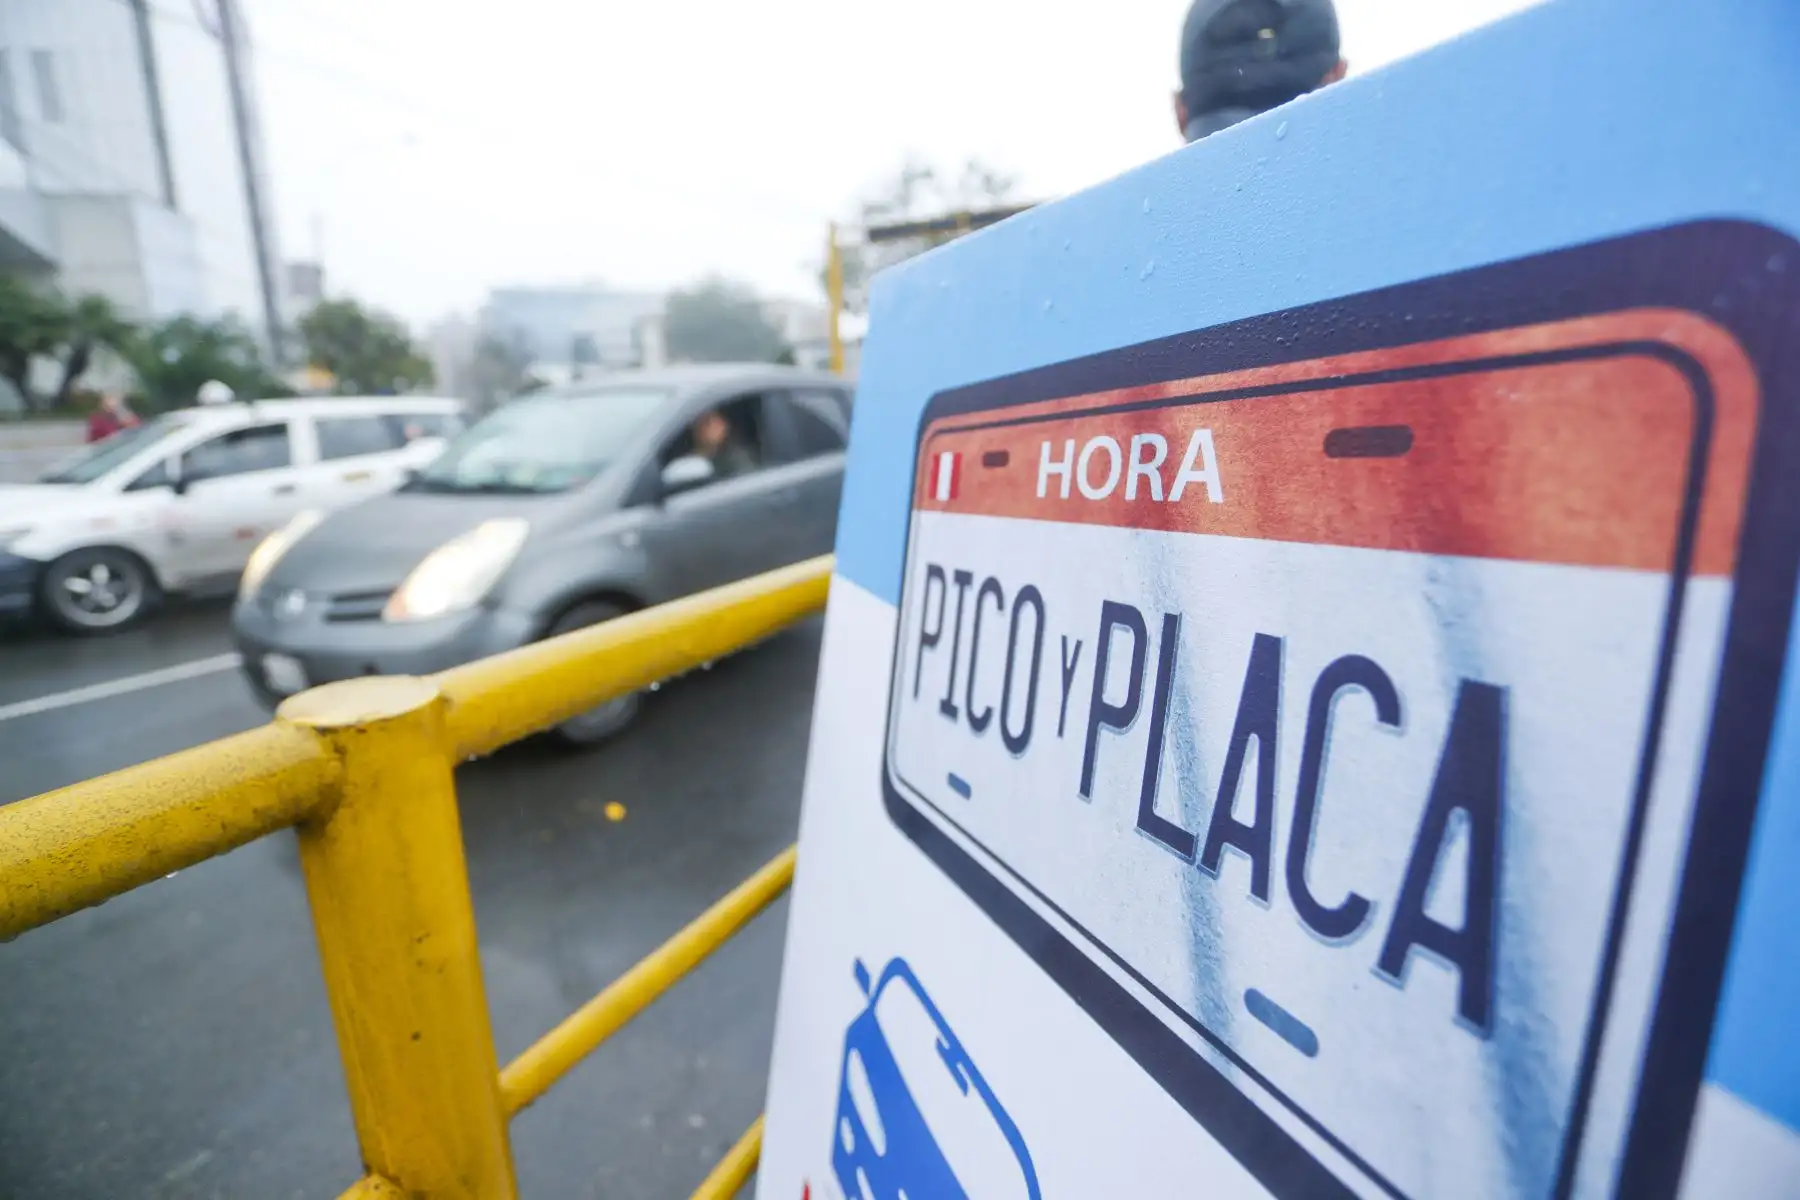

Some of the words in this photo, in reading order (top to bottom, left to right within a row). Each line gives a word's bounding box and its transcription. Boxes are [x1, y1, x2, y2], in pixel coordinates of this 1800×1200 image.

[1036, 428, 1224, 503] HORA
[914, 563, 1046, 759] PICO
[1057, 635, 1082, 738] Y
[1077, 599, 1511, 1041] PLACA
